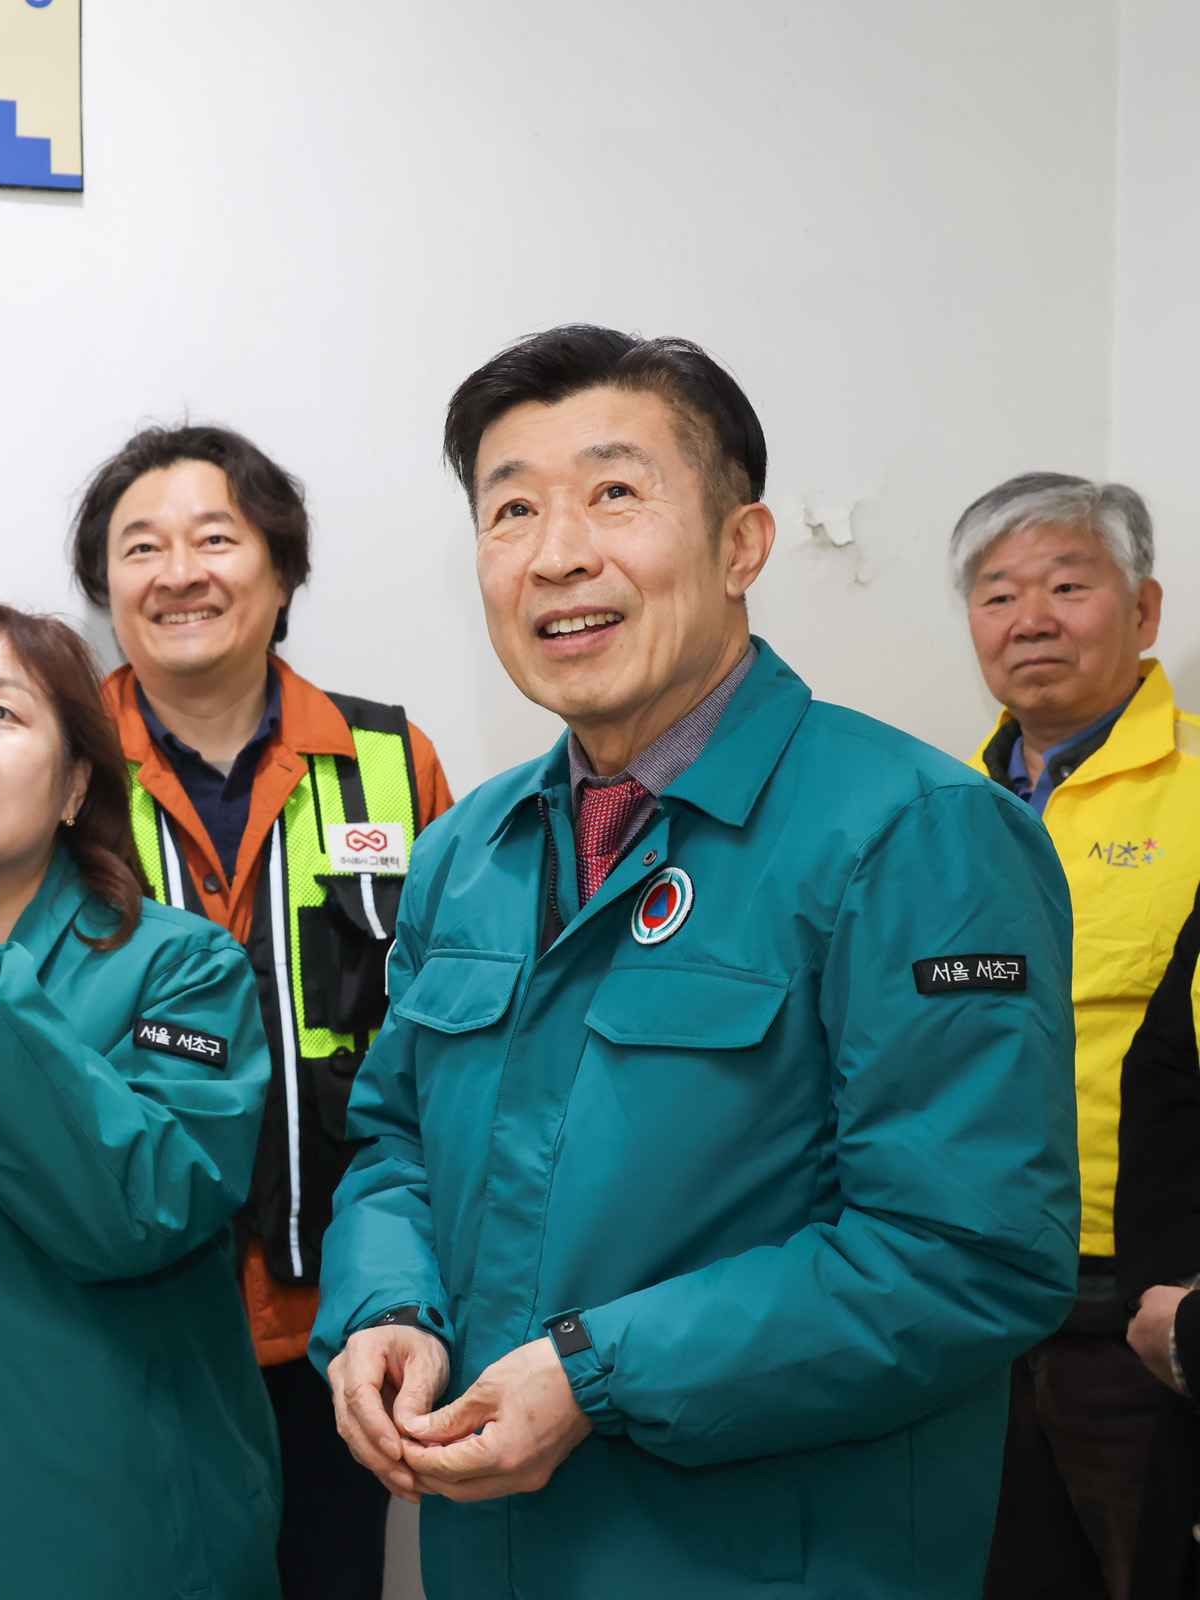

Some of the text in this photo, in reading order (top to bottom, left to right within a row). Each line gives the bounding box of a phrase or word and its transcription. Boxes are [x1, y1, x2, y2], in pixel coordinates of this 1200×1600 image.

[1087, 841, 1139, 869] 서초
[931, 960, 1020, 982] 서울 서초구
[140, 1025, 221, 1057] 서울 서초구
